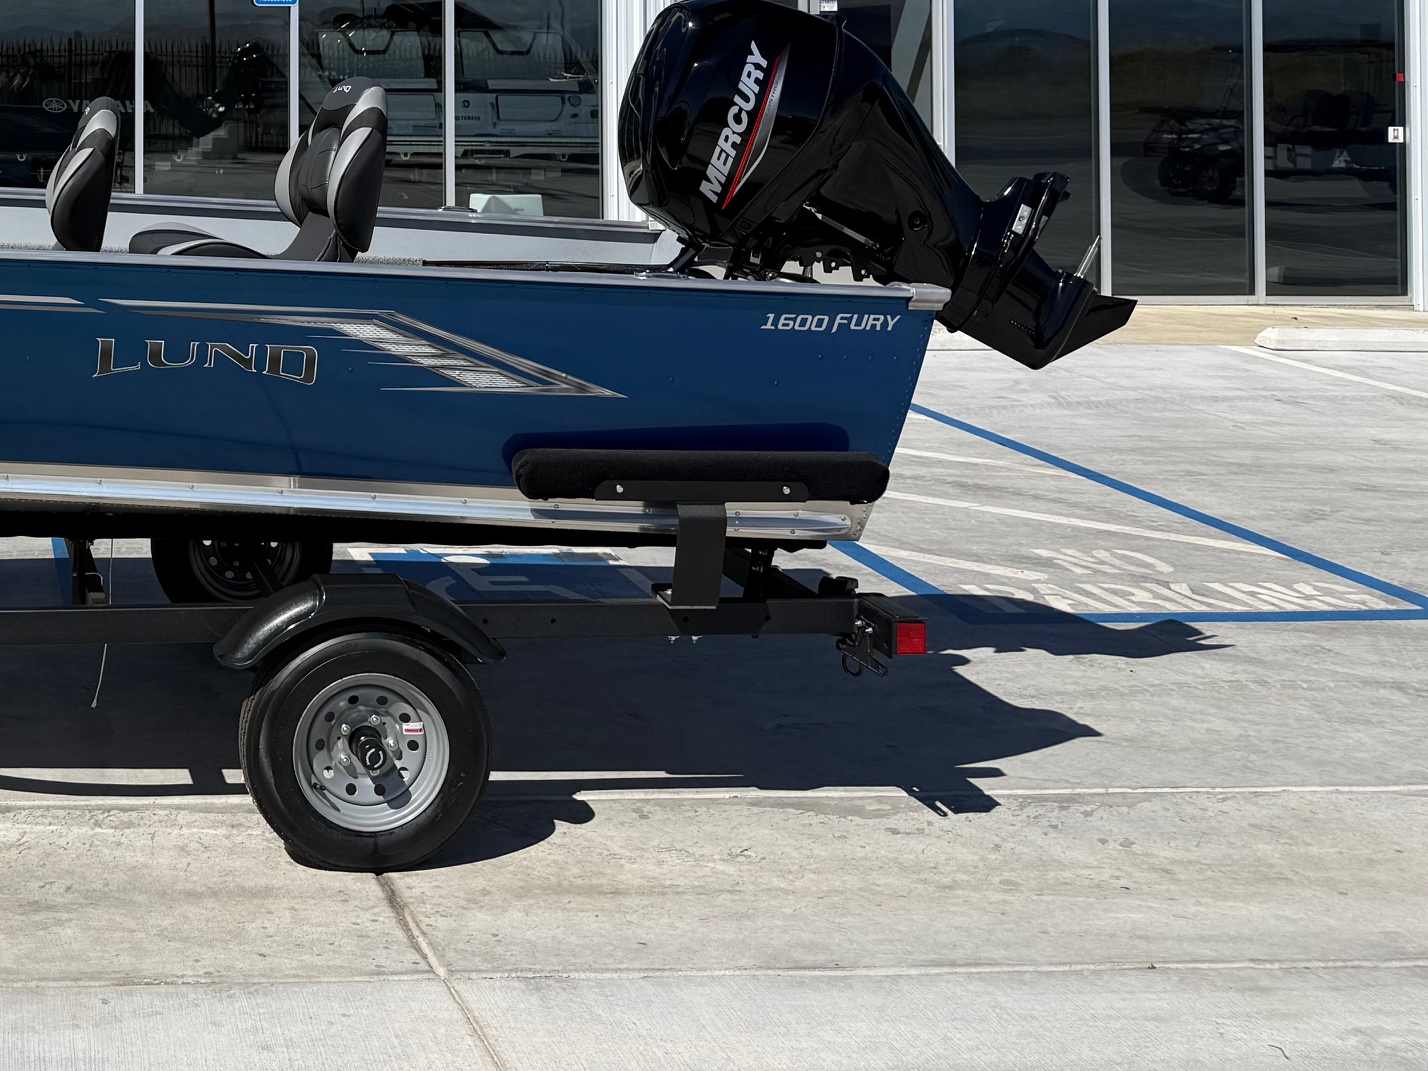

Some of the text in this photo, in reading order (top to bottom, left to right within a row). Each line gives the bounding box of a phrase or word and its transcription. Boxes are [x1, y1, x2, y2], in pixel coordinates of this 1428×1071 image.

[699, 40, 768, 204] MERCURY
[760, 313, 902, 334] 1600 FURY
[91, 337, 319, 386] LUND
[1029, 548, 1174, 575] NO
[958, 582, 1396, 612] PARKING
